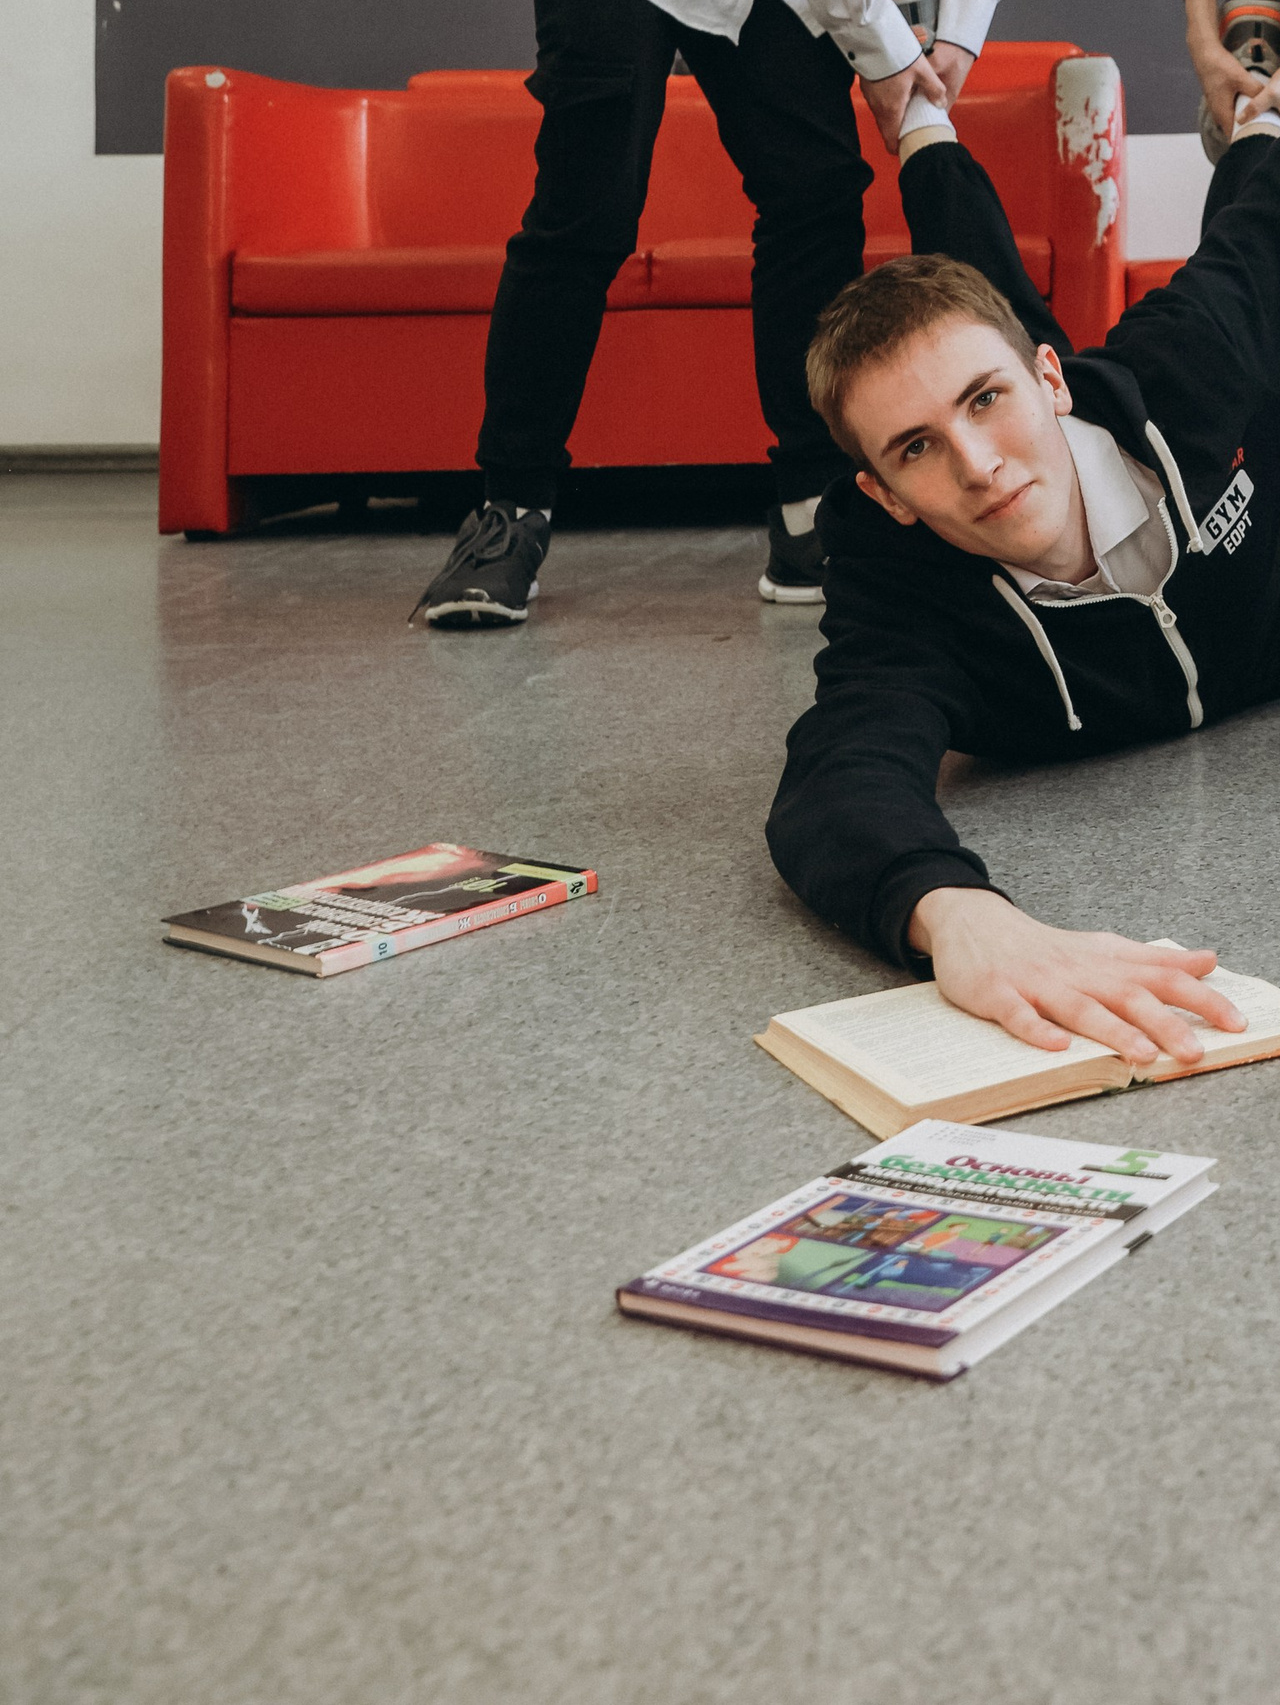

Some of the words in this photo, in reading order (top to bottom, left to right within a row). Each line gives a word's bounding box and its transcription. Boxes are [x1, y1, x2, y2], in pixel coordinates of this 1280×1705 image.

[1205, 483, 1247, 540] GYM
[377, 941, 389, 956] 10
[945, 1154, 1092, 1185] Основы
[1100, 1149, 1161, 1175] 5
